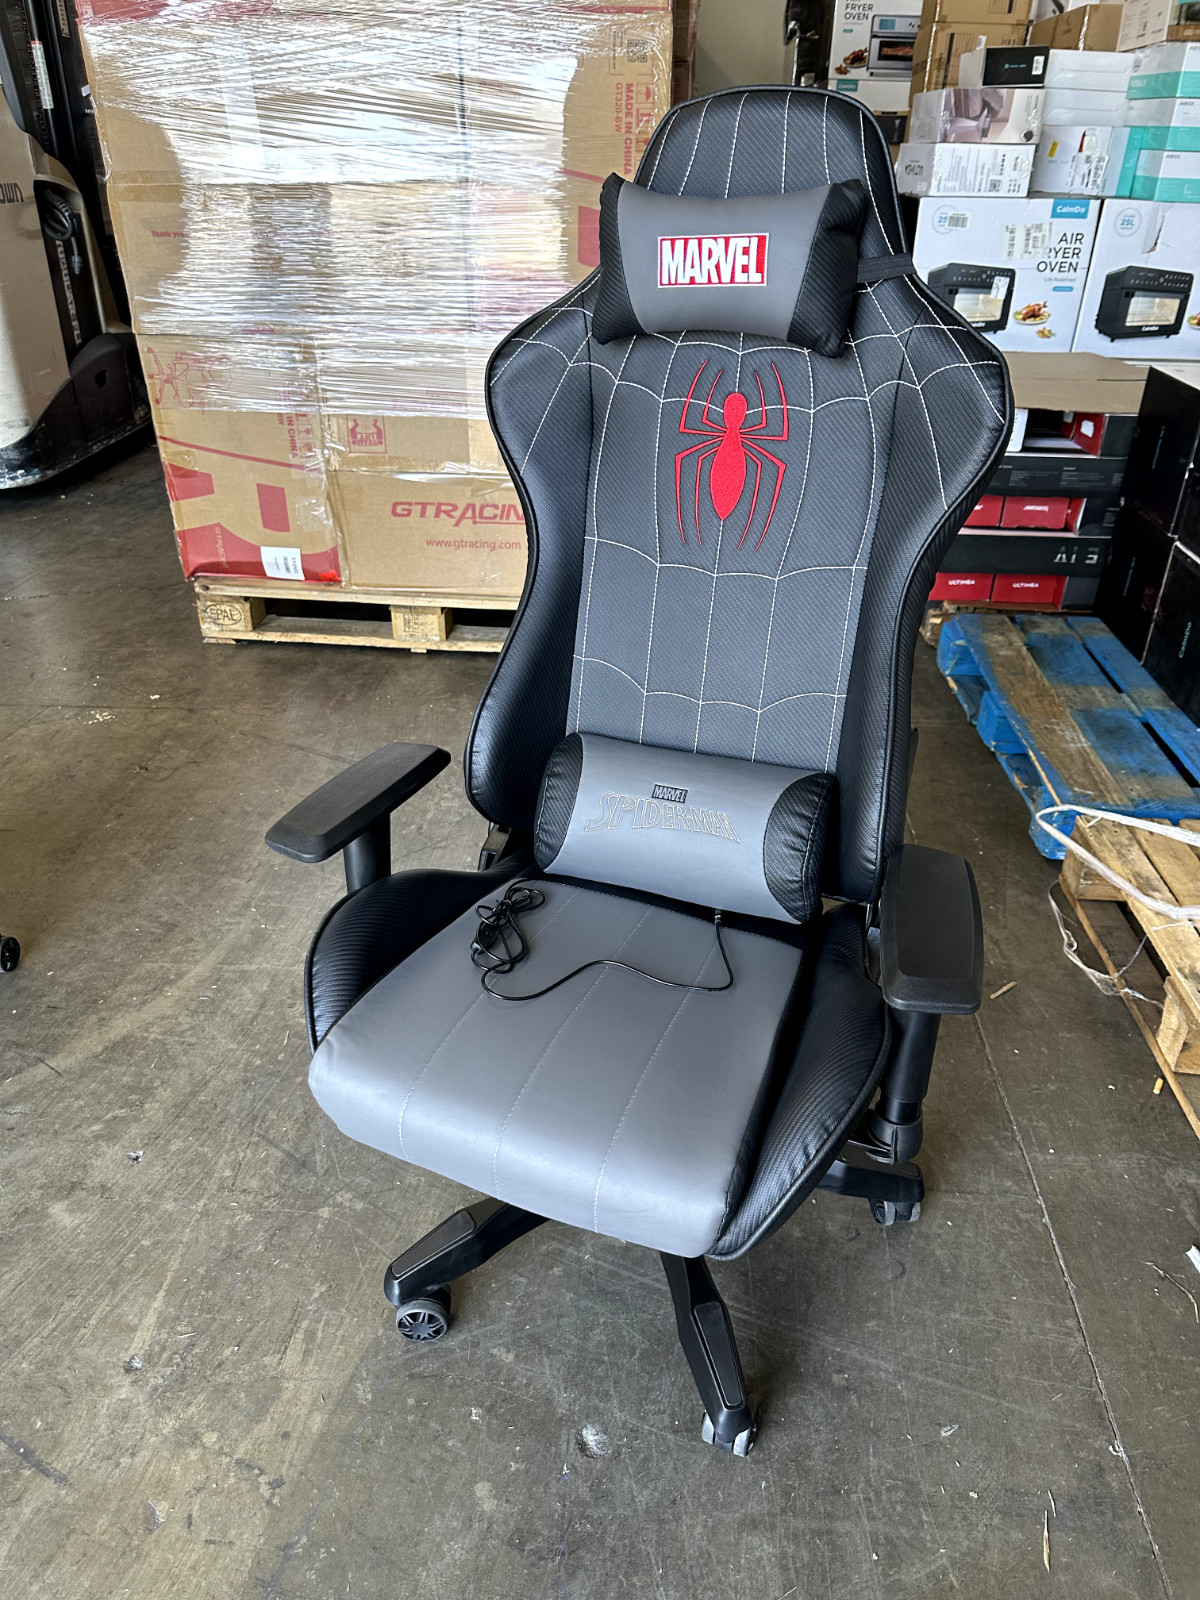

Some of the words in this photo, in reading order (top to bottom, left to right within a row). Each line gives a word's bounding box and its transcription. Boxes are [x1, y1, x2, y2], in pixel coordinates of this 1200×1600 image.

[845, 3, 874, 12] FRYER
[844, 12, 870, 21] OVEN
[624, 82, 634, 118] MADE
[614, 82, 624, 133] GT320-BW
[624, 120, 633, 134] IN
[623, 137, 633, 175] CHINA
[1056, 205, 1086, 213] CalmDo
[151, 230, 172, 238] Thank
[1058, 232, 1085, 245] AIR
[1047, 246, 1082, 260] RYER
[661, 237, 762, 285] MARVEL
[1036, 260, 1079, 273] OVEN
[287, 428, 299, 458] CHINA
[391, 501, 525, 527] GTRACIN
[426, 538, 522, 552] www.gtracing.com
[209, 608, 237, 622] EPAL
[654, 785, 687, 804] MARVEL
[585, 792, 742, 843] SPIDER-MAN
